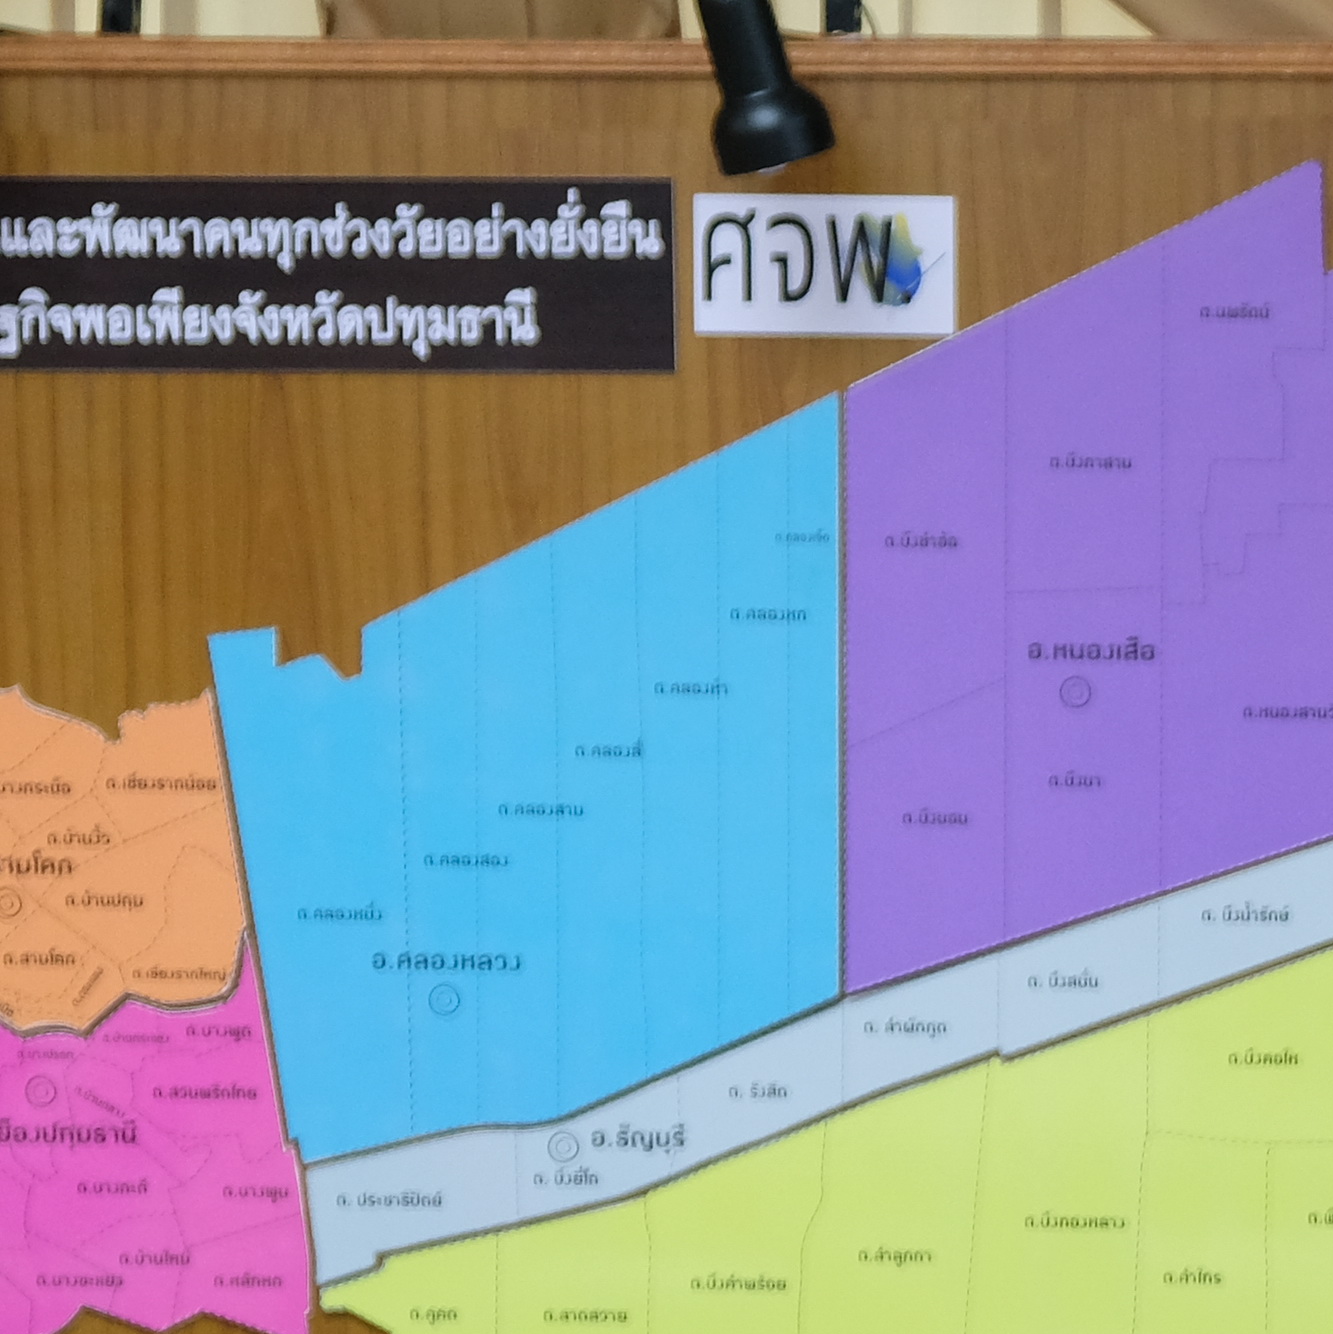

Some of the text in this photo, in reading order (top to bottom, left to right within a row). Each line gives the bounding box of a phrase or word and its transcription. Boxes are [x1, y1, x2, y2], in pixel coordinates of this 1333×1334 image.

[1, 187, 665, 274] และพัฒนาคนทุกช่วงวัยอย่างยั่งยืน
[702, 207, 893, 303] ศจพ
[1028, 636, 1155, 661] อ.หนองเสือ
[372, 951, 522, 971] อ.คลองหลวง
[592, 1123, 685, 1154] อ.ธัญบุรี
